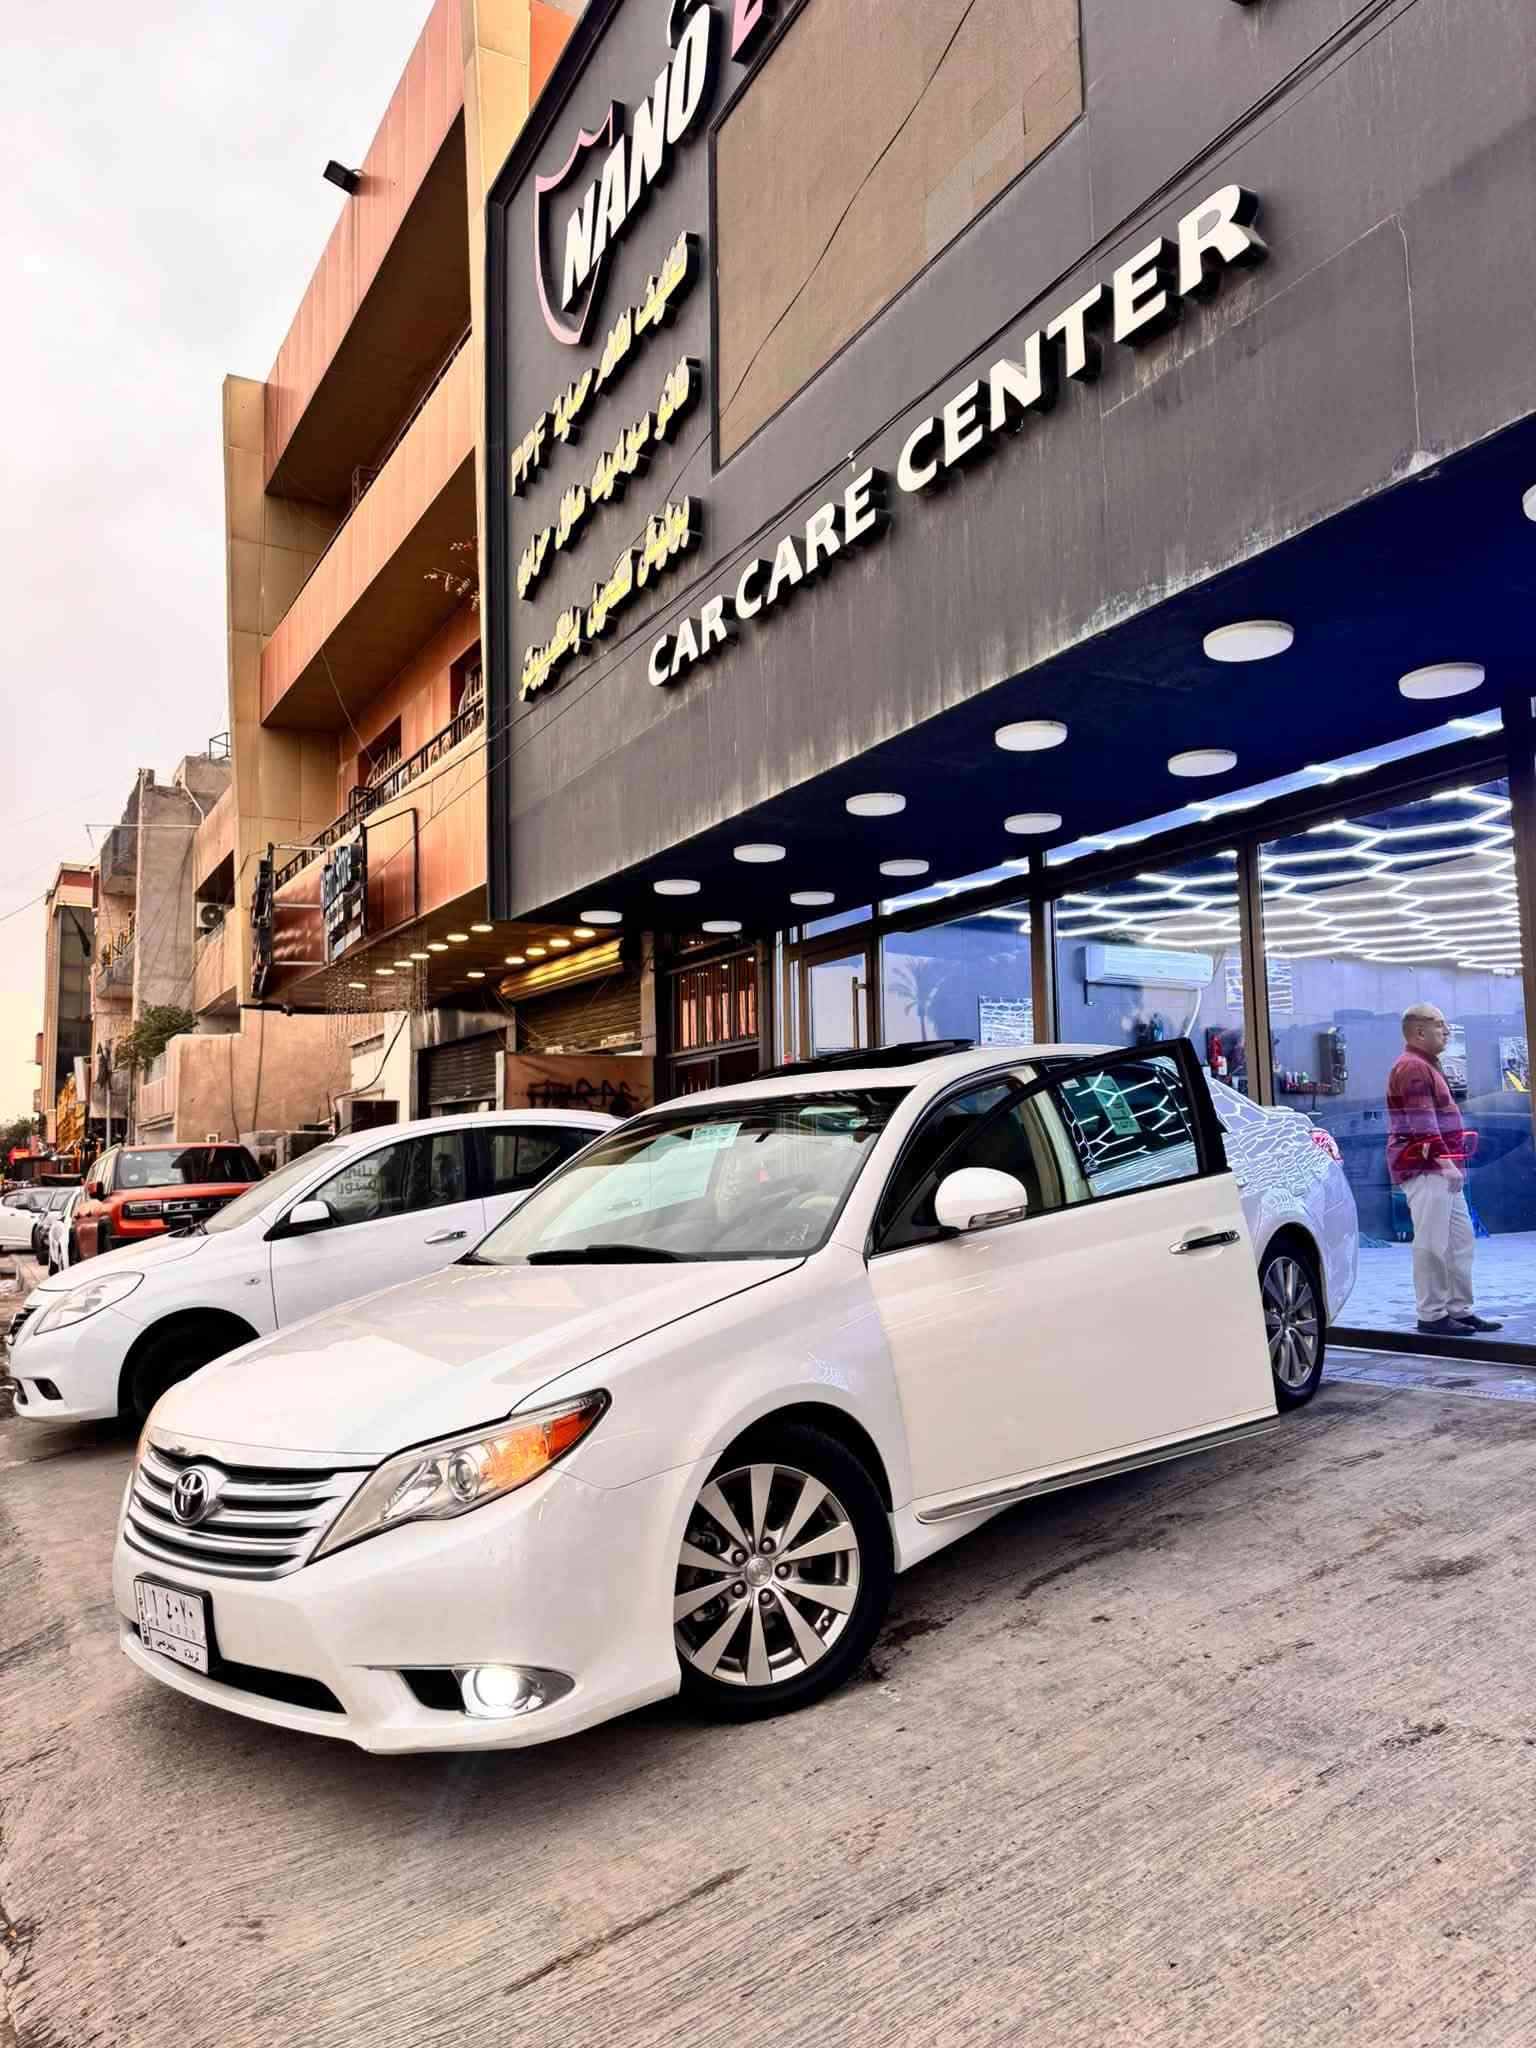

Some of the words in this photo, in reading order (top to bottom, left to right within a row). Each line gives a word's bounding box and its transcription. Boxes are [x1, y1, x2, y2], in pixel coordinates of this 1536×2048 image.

[561, 4, 710, 311] NANO
[510, 411, 546, 497] PPF
[648, 593, 729, 687] CAR
[735, 467, 878, 620] CARE
[897, 184, 1252, 493] CENTER
